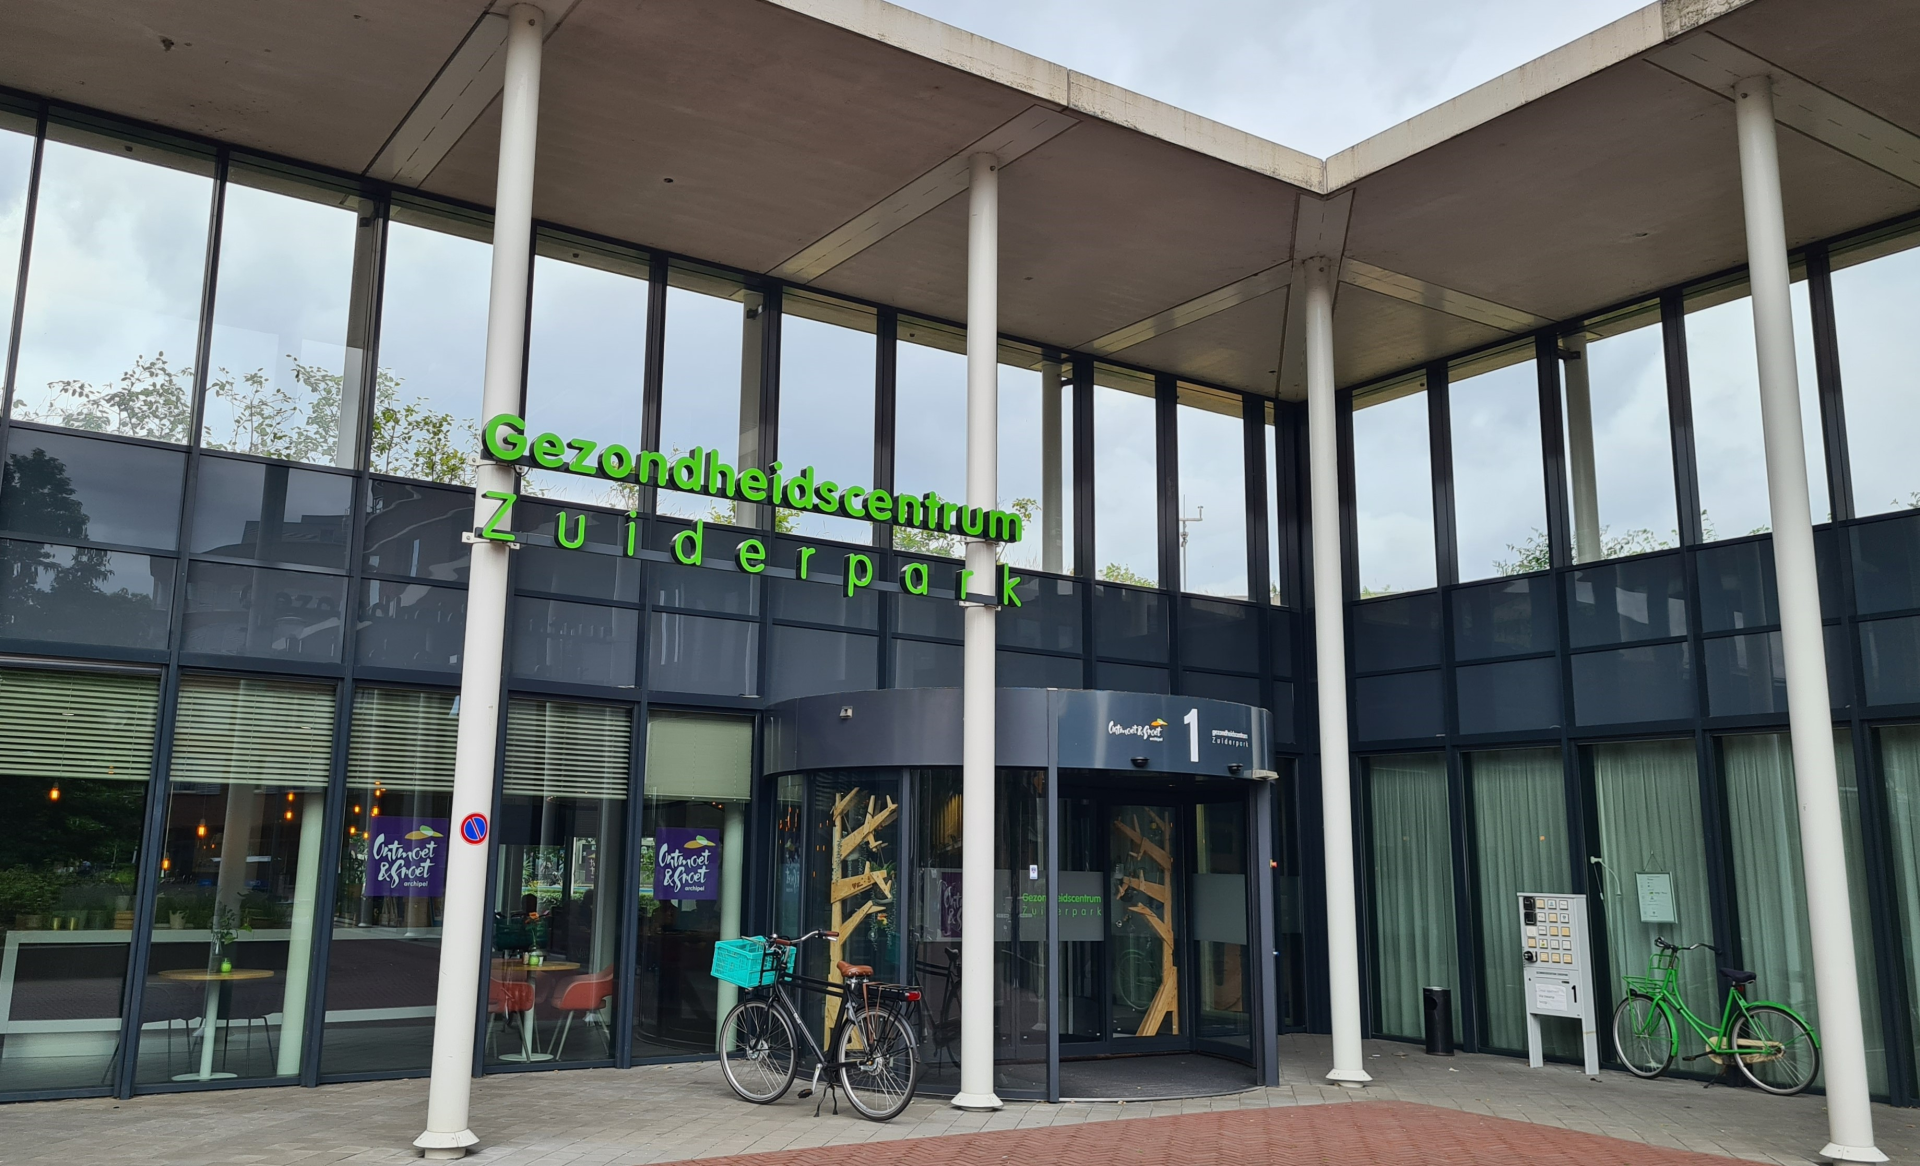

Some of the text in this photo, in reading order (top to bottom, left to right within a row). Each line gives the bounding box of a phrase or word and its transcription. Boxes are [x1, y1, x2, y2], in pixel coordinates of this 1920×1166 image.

[482, 414, 1022, 542] Gezondheidscentrum
[482, 491, 1022, 607] Zuiderpark
[1184, 708, 1199, 762] 1
[1212, 737, 1249, 748] Zuiderpark
[373, 833, 438, 862] Ontmoet
[659, 843, 711, 868] Ontmoet
[378, 858, 435, 888] &Groet
[664, 865, 710, 892] &Groet
[1571, 985, 1577, 1003] 1
